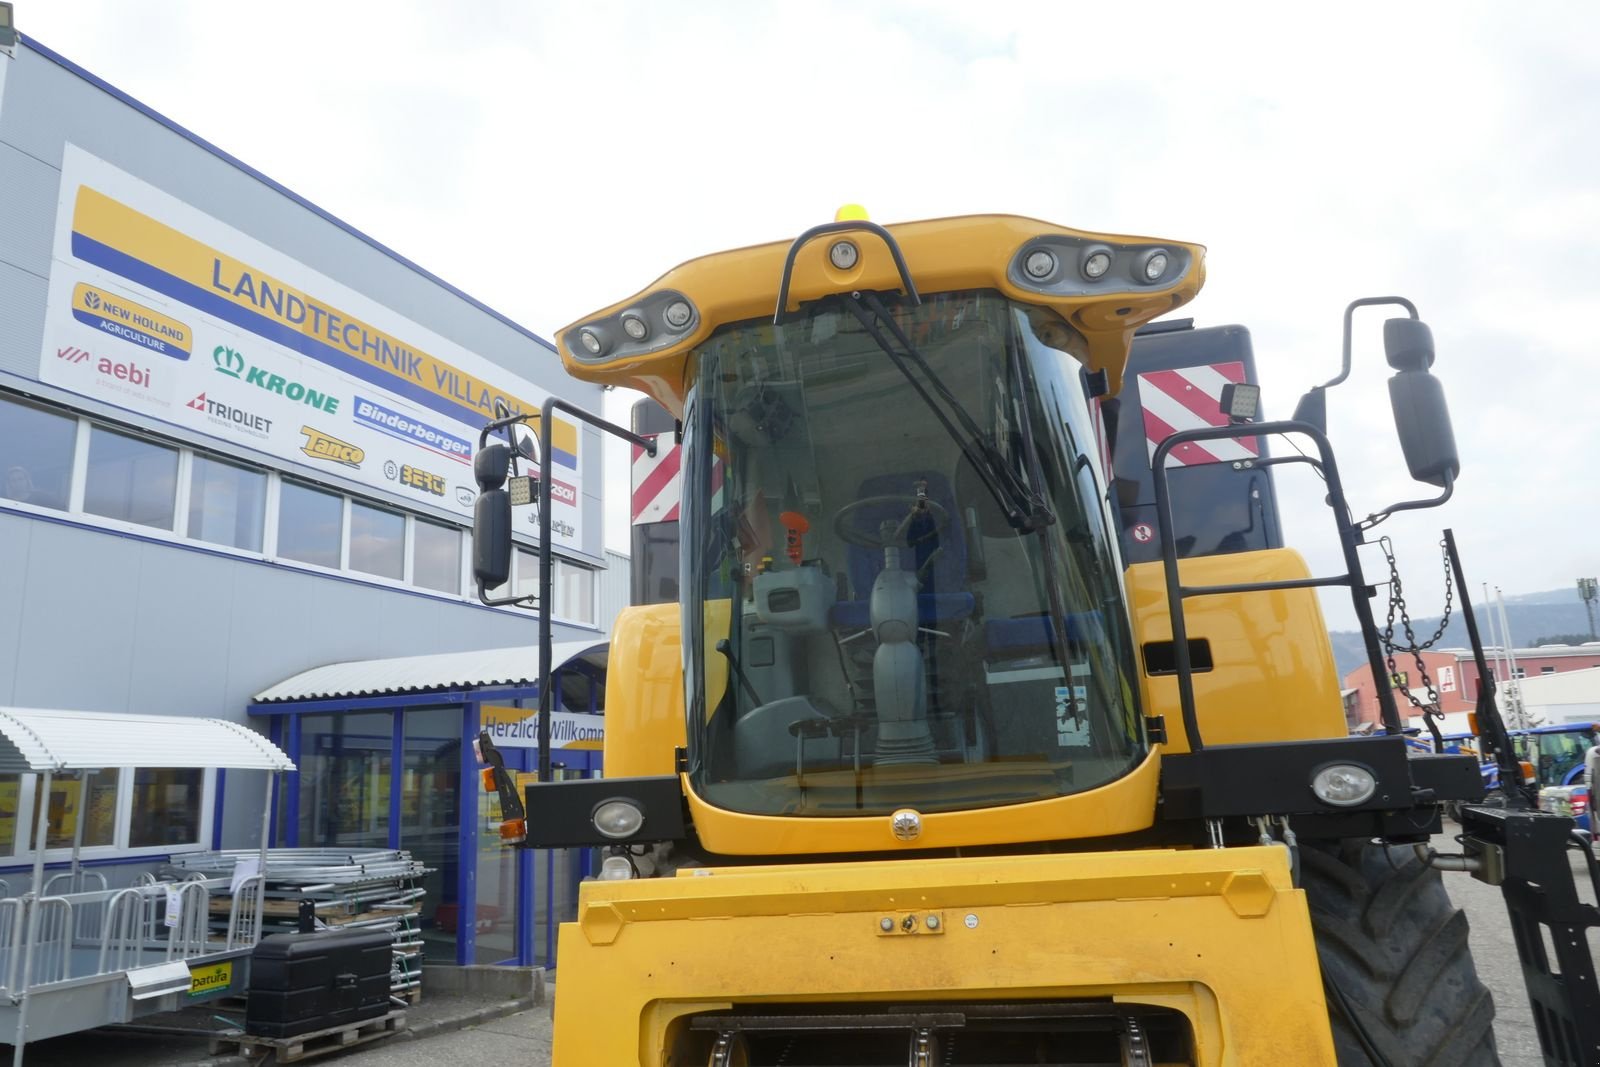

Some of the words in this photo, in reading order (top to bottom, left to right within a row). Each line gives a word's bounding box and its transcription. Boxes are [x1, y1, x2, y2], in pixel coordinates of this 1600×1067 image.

[101, 320, 166, 352] AGRICULTURE
[103, 302, 131, 321] NEW
[132, 313, 185, 342] HOLLAND
[212, 258, 423, 382] LANDTECHNIK
[98, 357, 151, 388] aebi
[245, 366, 341, 415] KRONE
[206, 398, 273, 434] TRIOLIET
[357, 401, 470, 455] Binderberger
[299, 424, 366, 466] Tanco
[485, 714, 540, 740] Herzlich
[549, 719, 605, 742] Willkomm
[192, 972, 228, 991] patura
